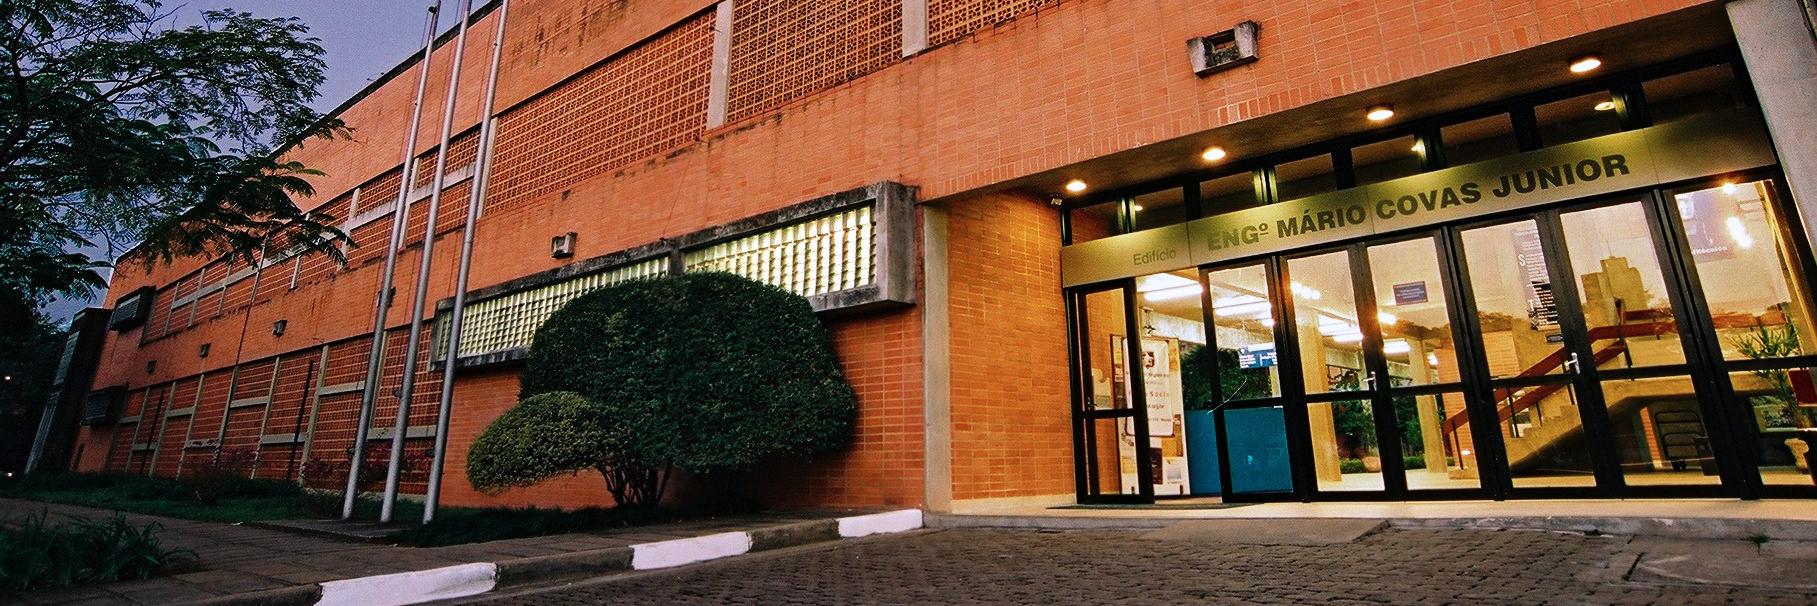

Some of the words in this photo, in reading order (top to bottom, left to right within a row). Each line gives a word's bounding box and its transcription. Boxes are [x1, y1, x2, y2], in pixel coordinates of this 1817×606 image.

[1133, 248, 1177, 266] Edifício
[1206, 222, 1269, 251] ENGº
[1276, 204, 1367, 239] MÁRIO
[1375, 182, 1482, 220] COVAS
[1492, 153, 1630, 198] JUNIOR
